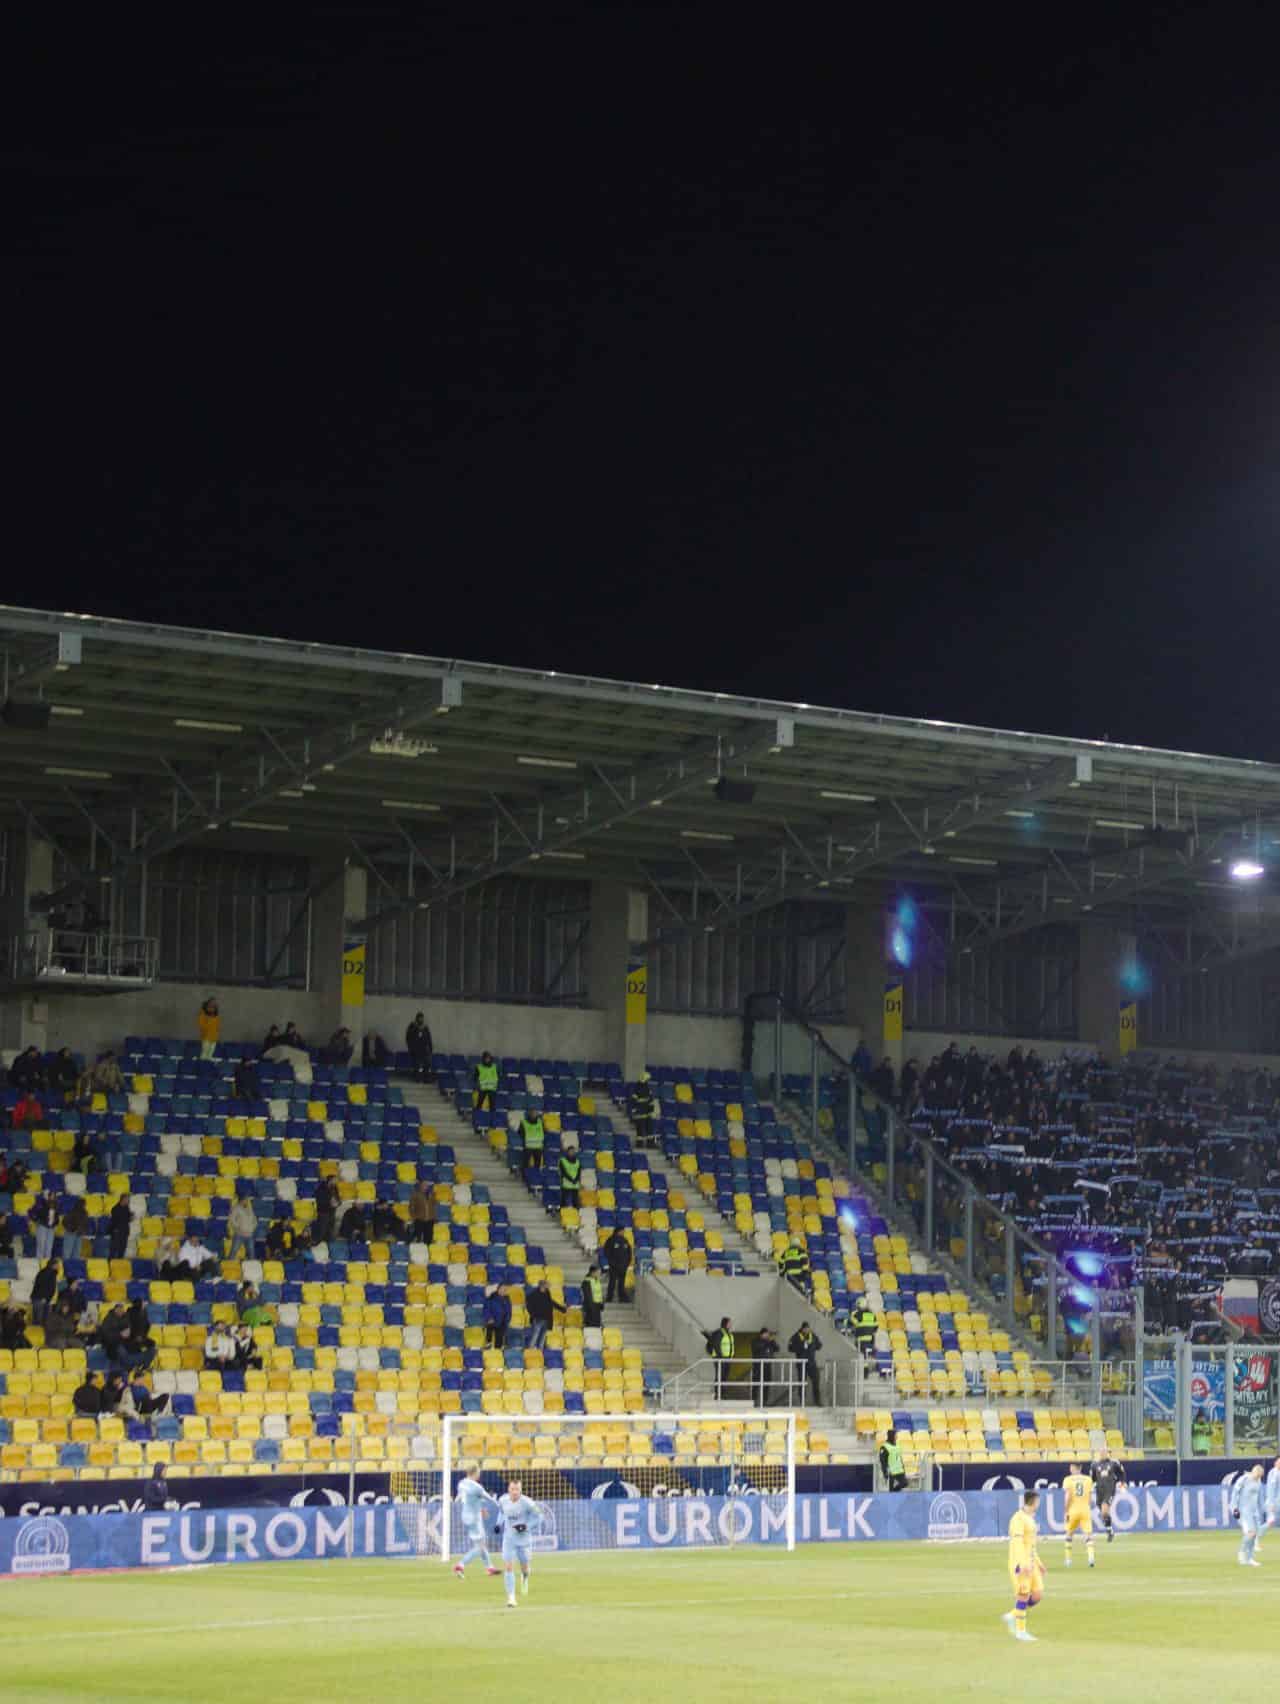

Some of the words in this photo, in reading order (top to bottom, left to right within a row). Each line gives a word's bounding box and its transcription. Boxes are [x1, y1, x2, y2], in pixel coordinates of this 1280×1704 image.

[343, 959, 365, 976] D2
[627, 982, 647, 995] D2
[885, 999, 901, 1013] D1
[616, 1496, 876, 1546] EUROMILK
[140, 1508, 445, 1564] EUROMILK
